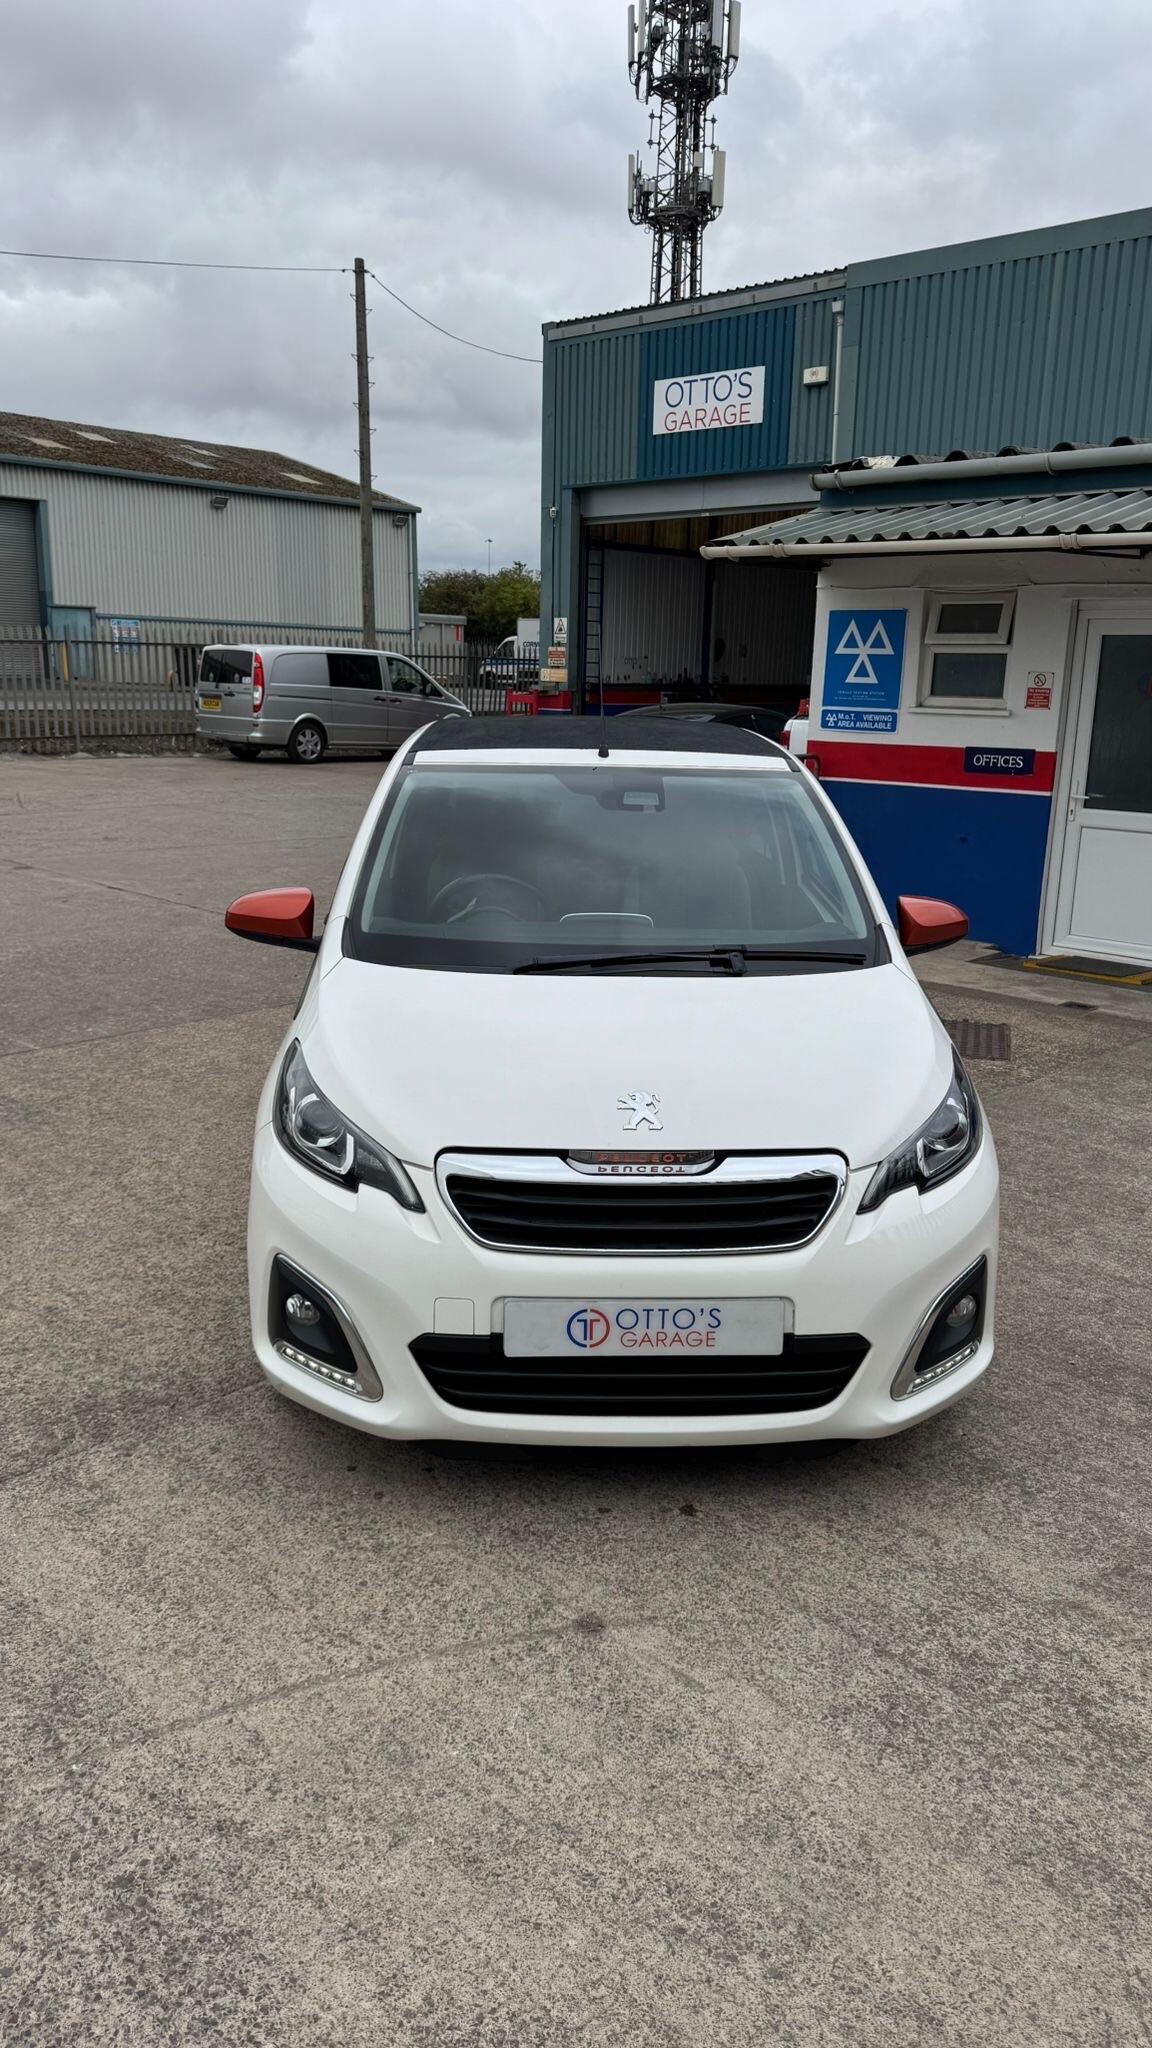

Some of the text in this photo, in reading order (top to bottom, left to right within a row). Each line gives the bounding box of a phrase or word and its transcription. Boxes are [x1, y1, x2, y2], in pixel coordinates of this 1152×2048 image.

[665, 371, 752, 408] OTTO'S
[664, 402, 750, 431] GARAGE
[837, 720, 892, 730] AREA AVAILABLE
[862, 714, 893, 722] VIEWING
[973, 754, 1024, 768] OFFICES
[615, 1307, 722, 1330] OTTO'S
[620, 1331, 716, 1348] GARAGE
